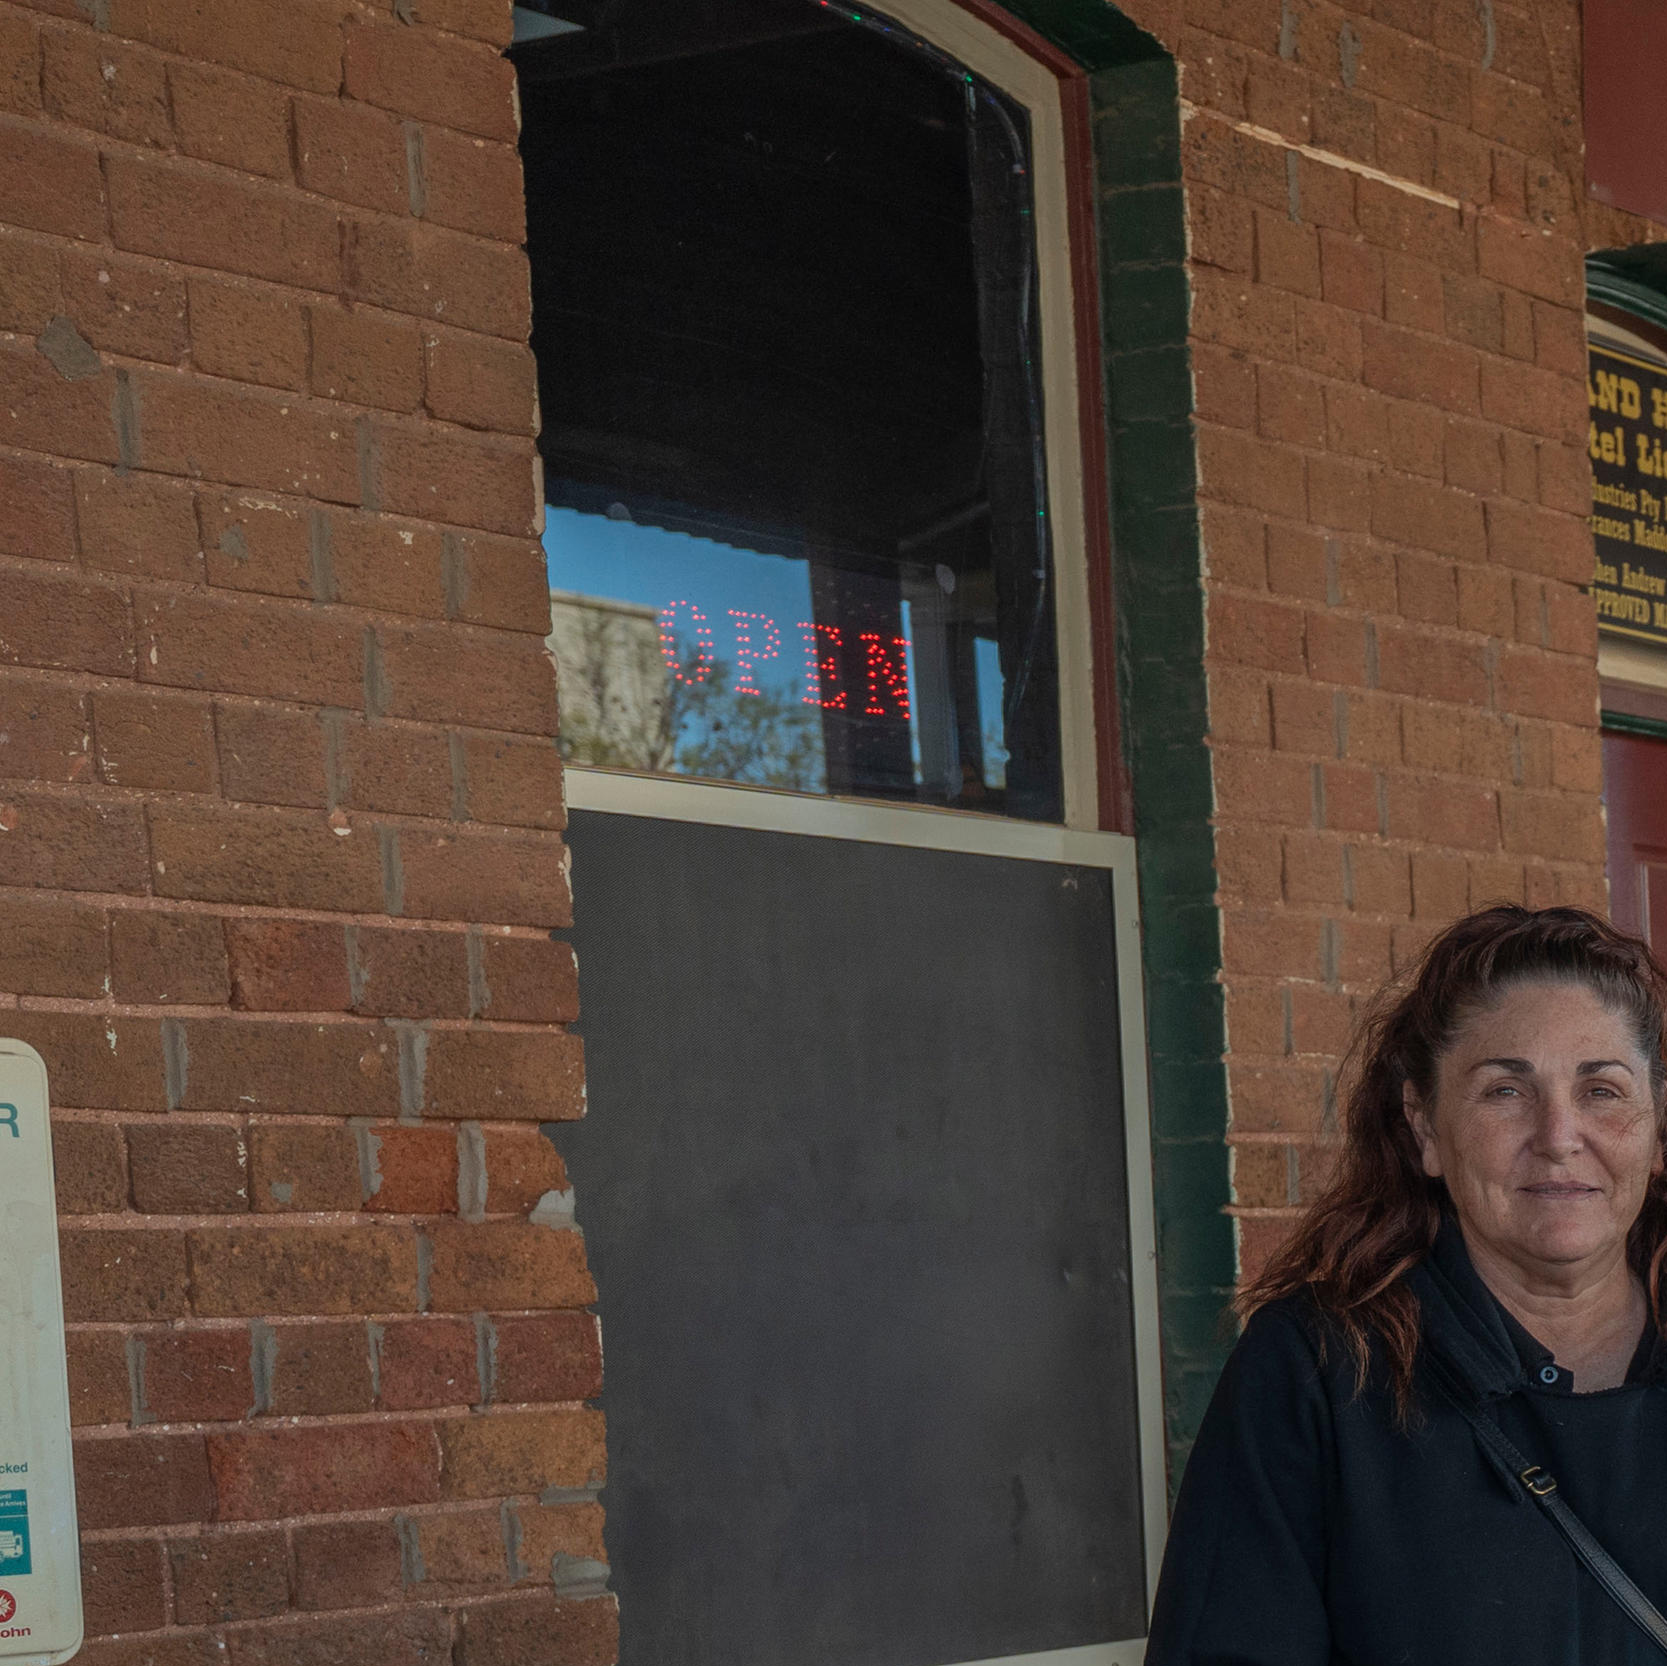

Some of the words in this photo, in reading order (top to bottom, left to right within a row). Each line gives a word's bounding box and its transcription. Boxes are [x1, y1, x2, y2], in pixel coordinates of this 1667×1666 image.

[1640, 488, 1661, 523] Pty
[1622, 562, 1666, 597] Andrew
[658, 599, 913, 720] OPEN
